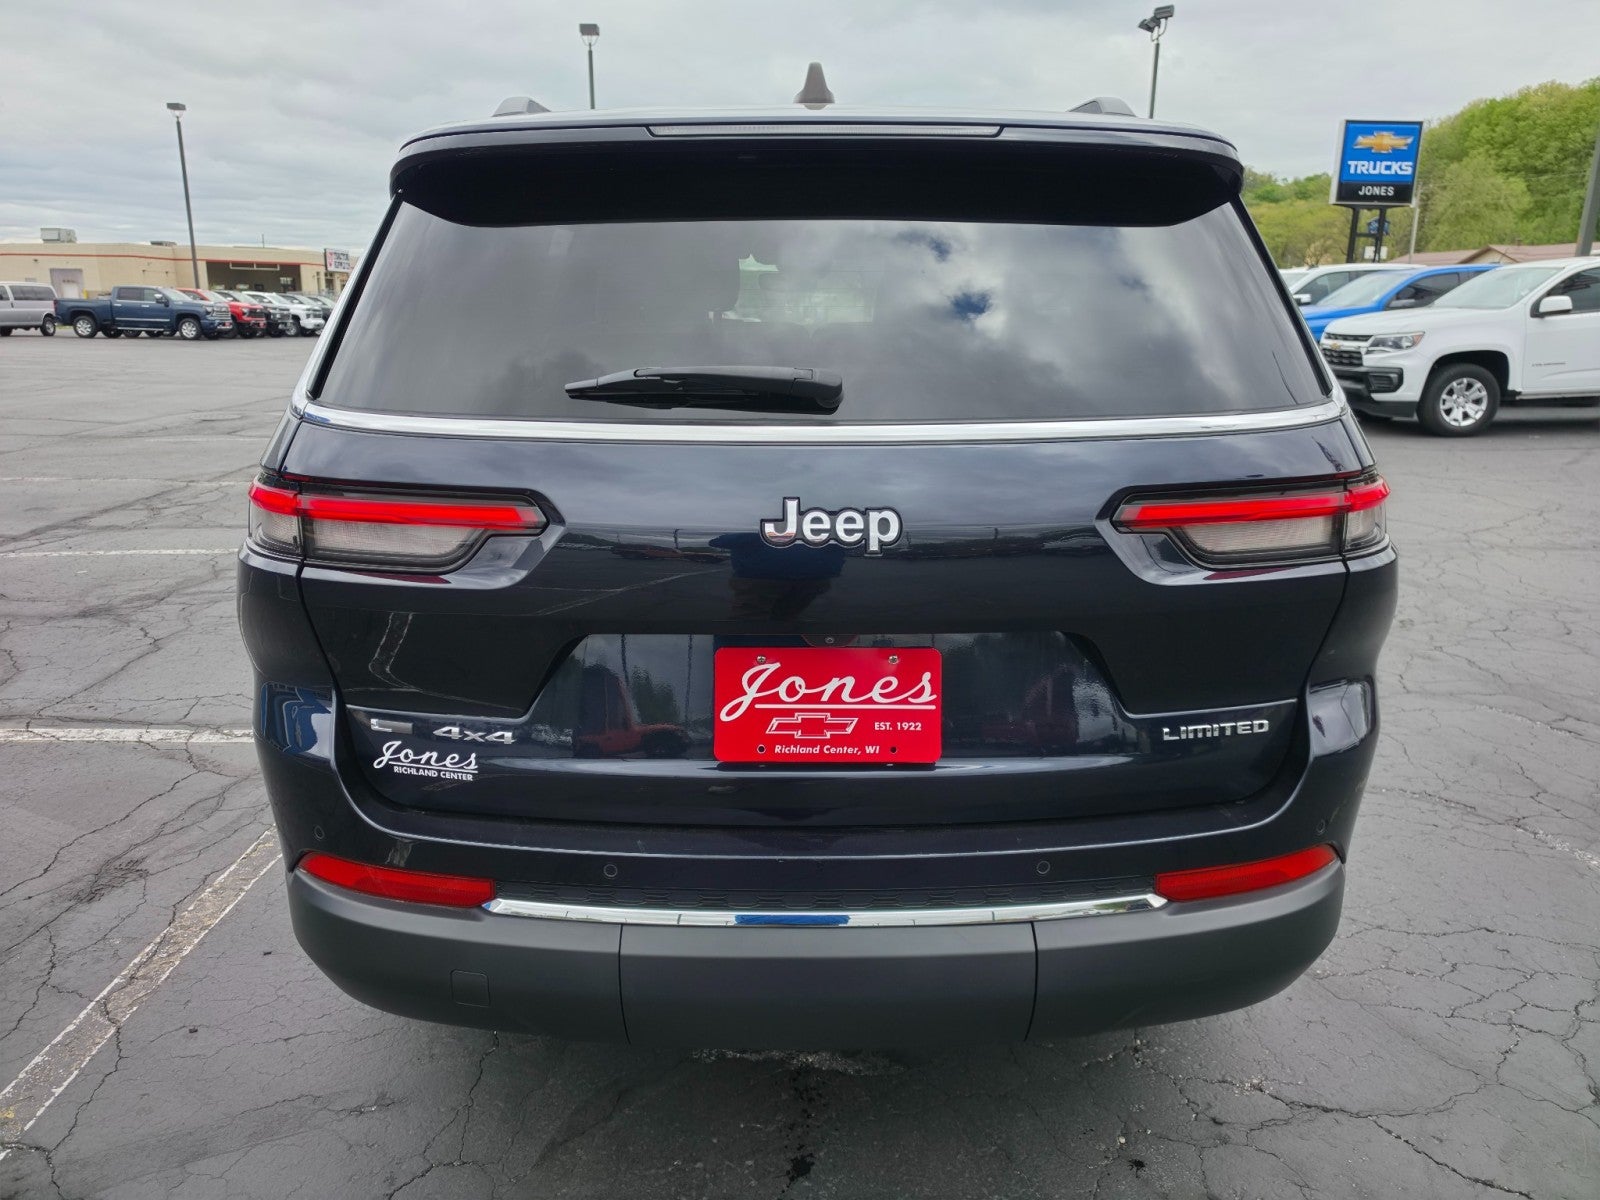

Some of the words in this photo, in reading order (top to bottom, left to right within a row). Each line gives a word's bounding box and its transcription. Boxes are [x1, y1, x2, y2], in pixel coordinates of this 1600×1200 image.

[1347, 160, 1414, 175] TRUCKS
[1358, 185, 1395, 196] JONES
[763, 498, 900, 552] Jeep
[719, 662, 937, 722] Jones
[432, 726, 517, 745] 4x4
[874, 722, 893, 731] EST.
[896, 722, 922, 731] 1922
[1162, 719, 1270, 741] LIMITED
[373, 740, 479, 769] Jones
[774, 744, 820, 754] Richland
[823, 744, 862, 755] Center,
[865, 745, 880, 754] WI
[393, 765, 438, 778] RICHLAND
[440, 771, 474, 782] CENTER
